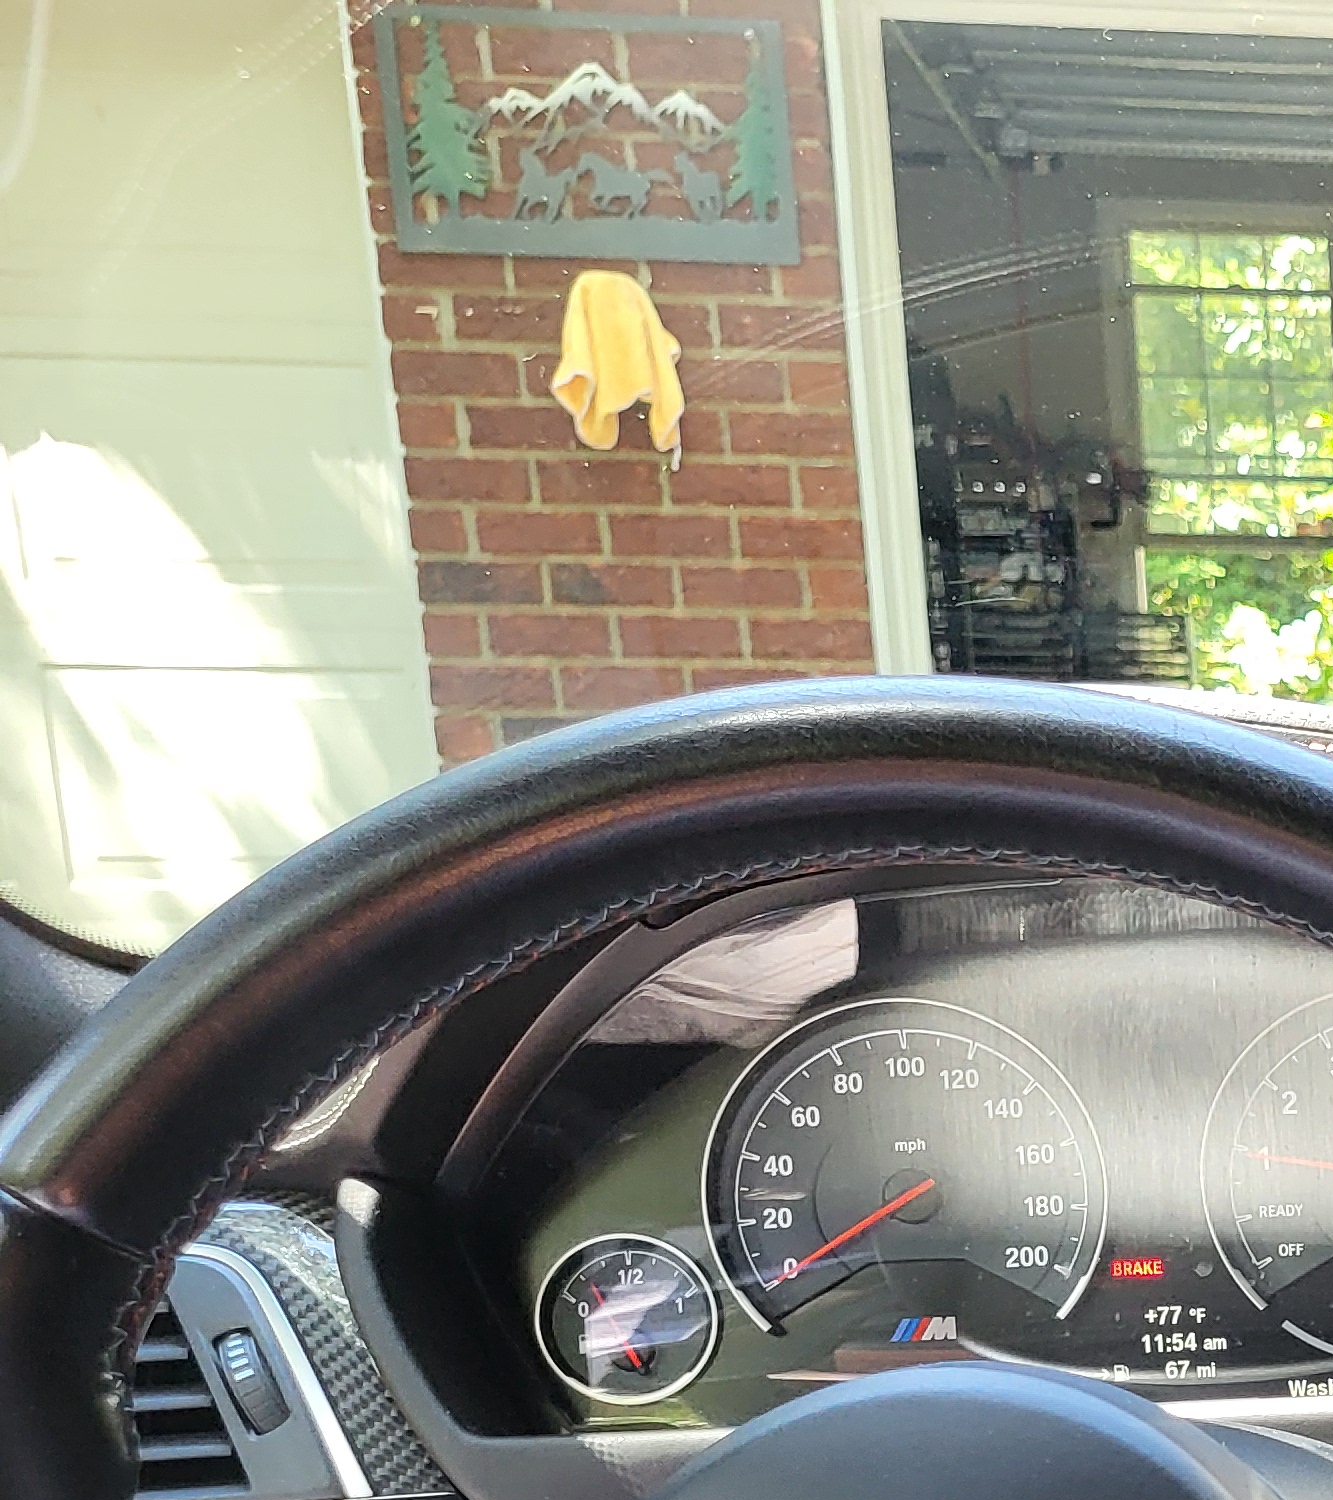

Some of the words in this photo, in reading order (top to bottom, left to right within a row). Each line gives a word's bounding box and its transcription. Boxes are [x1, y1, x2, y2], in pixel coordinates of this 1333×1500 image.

[885, 1056, 926, 1077] 100
[833, 1072, 863, 1094] 80
[939, 1069, 980, 1090] 120
[984, 1098, 1023, 1119] 140
[1282, 1090, 1298, 1114] 2
[791, 1105, 821, 1127] 60
[894, 1138, 926, 1154] mph
[1015, 1144, 1055, 1165] 160
[763, 1155, 793, 1177] 40
[1024, 1196, 1064, 1217] 180
[1258, 1204, 1303, 1219] READY
[763, 1208, 793, 1230] 20
[1005, 1246, 1049, 1268] 200
[1278, 1243, 1304, 1257] OFF
[617, 1268, 644, 1285] 1/2
[1112, 1259, 1163, 1277] BRAKE
[577, 1301, 590, 1318] 0
[675, 1298, 684, 1314] 1
[1144, 1306, 1182, 1325] +77
[1140, 1332, 1198, 1354] 11:54
[1203, 1337, 1228, 1351] am
[1165, 1360, 1190, 1380] 67
[1197, 1362, 1217, 1379] mi
